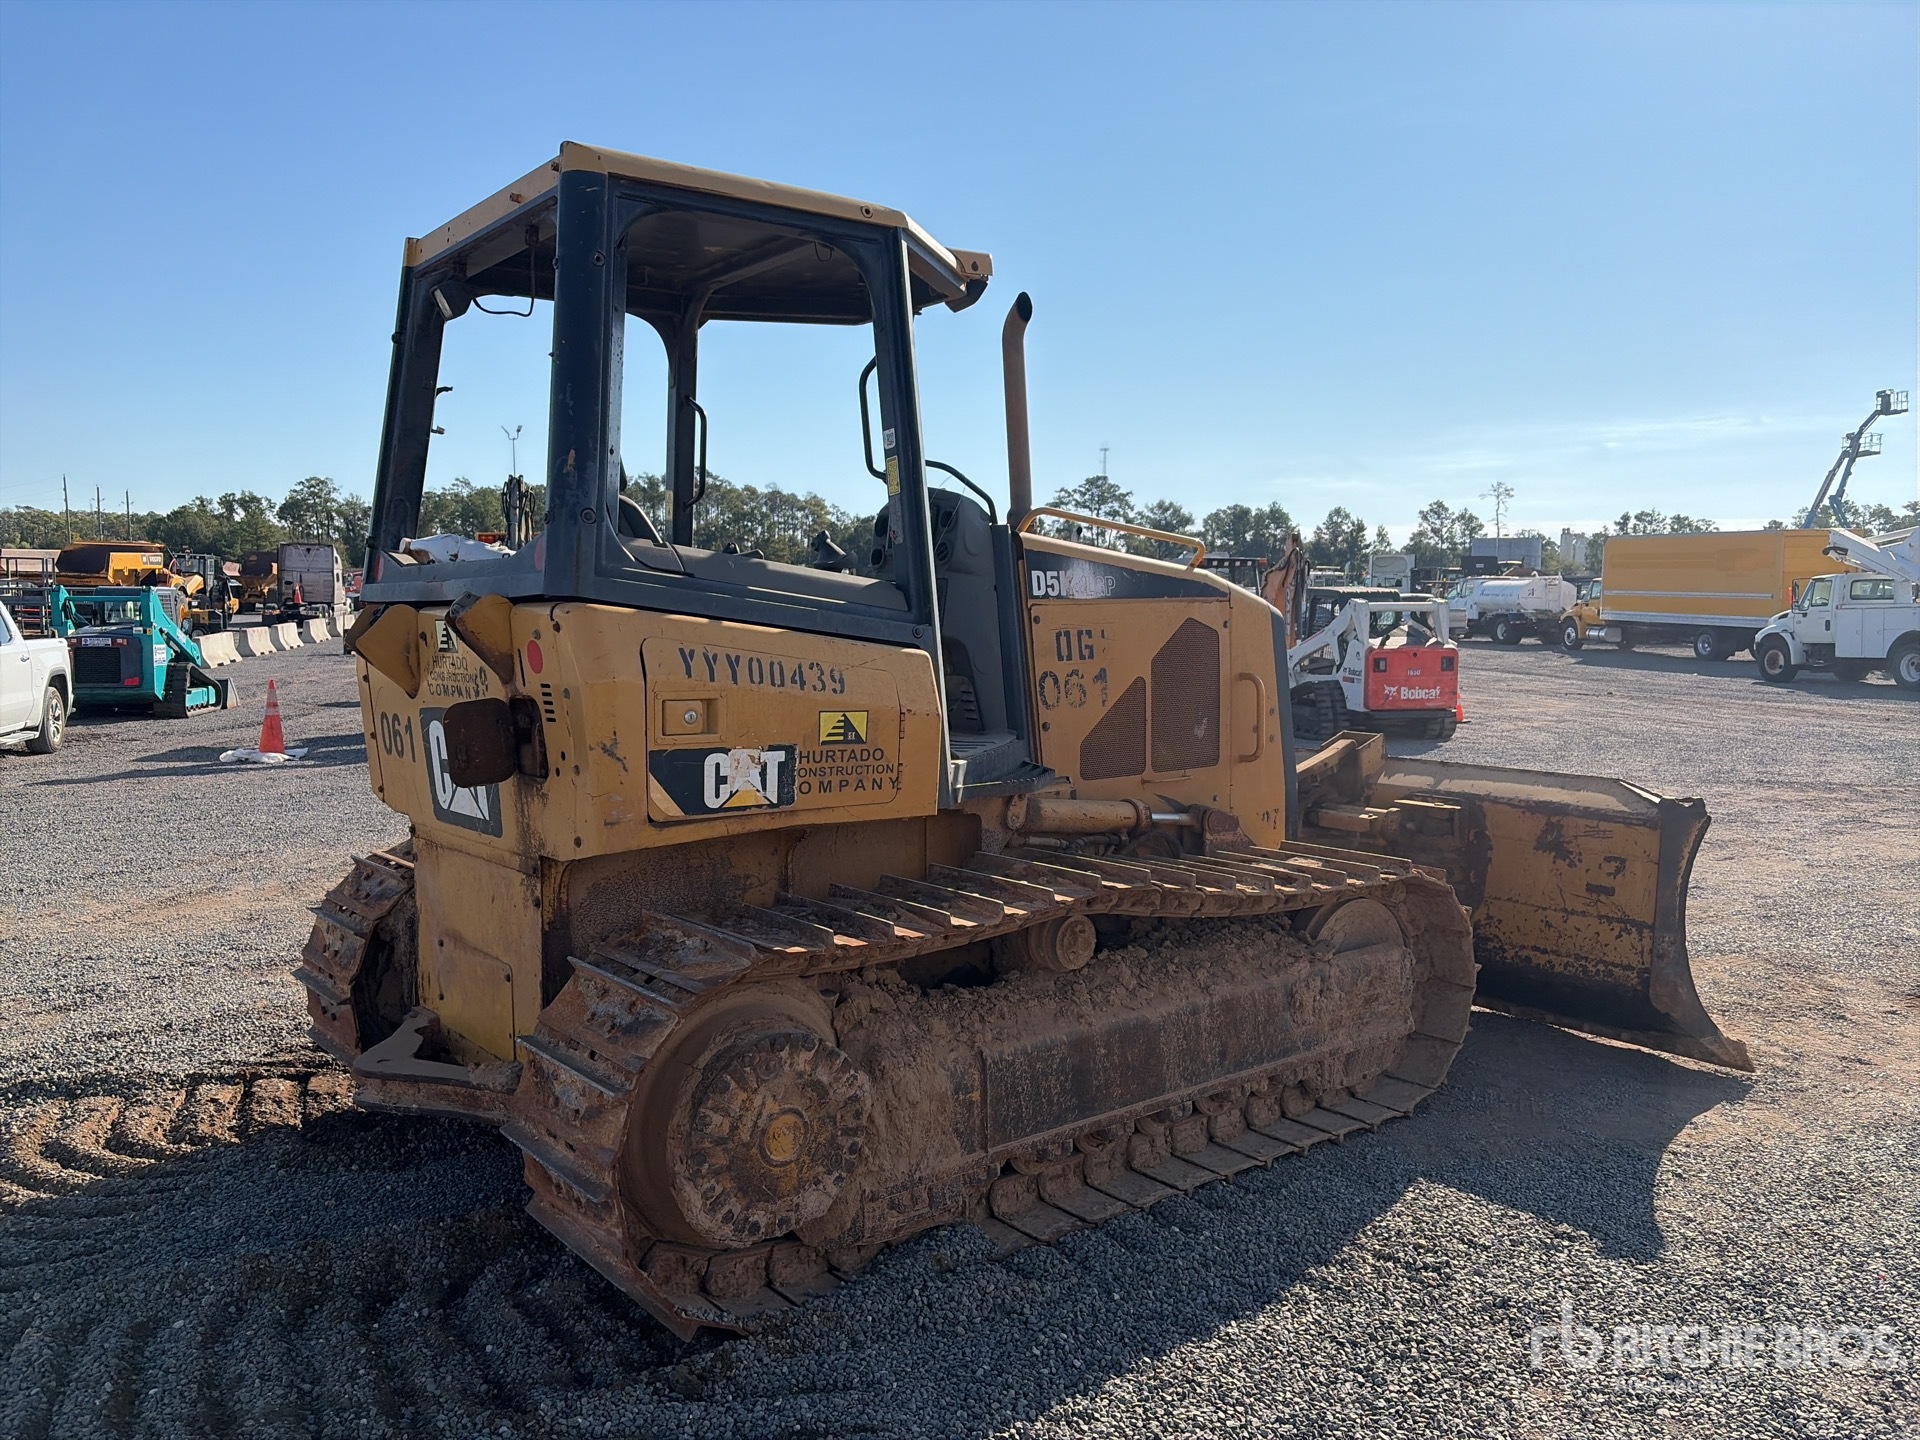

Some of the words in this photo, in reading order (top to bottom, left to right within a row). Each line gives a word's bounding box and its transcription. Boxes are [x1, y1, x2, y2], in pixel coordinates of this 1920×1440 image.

[678, 647, 846, 695] YYY00439
[1038, 667, 1109, 711] 061
[1400, 686, 1441, 700] Bobcat
[380, 711, 416, 763] 061
[798, 763, 895, 778] ONSTRUCTION
[799, 748, 884, 765] HURTADO
[703, 749, 787, 810] CAT
[798, 776, 900, 796] OMPANY
